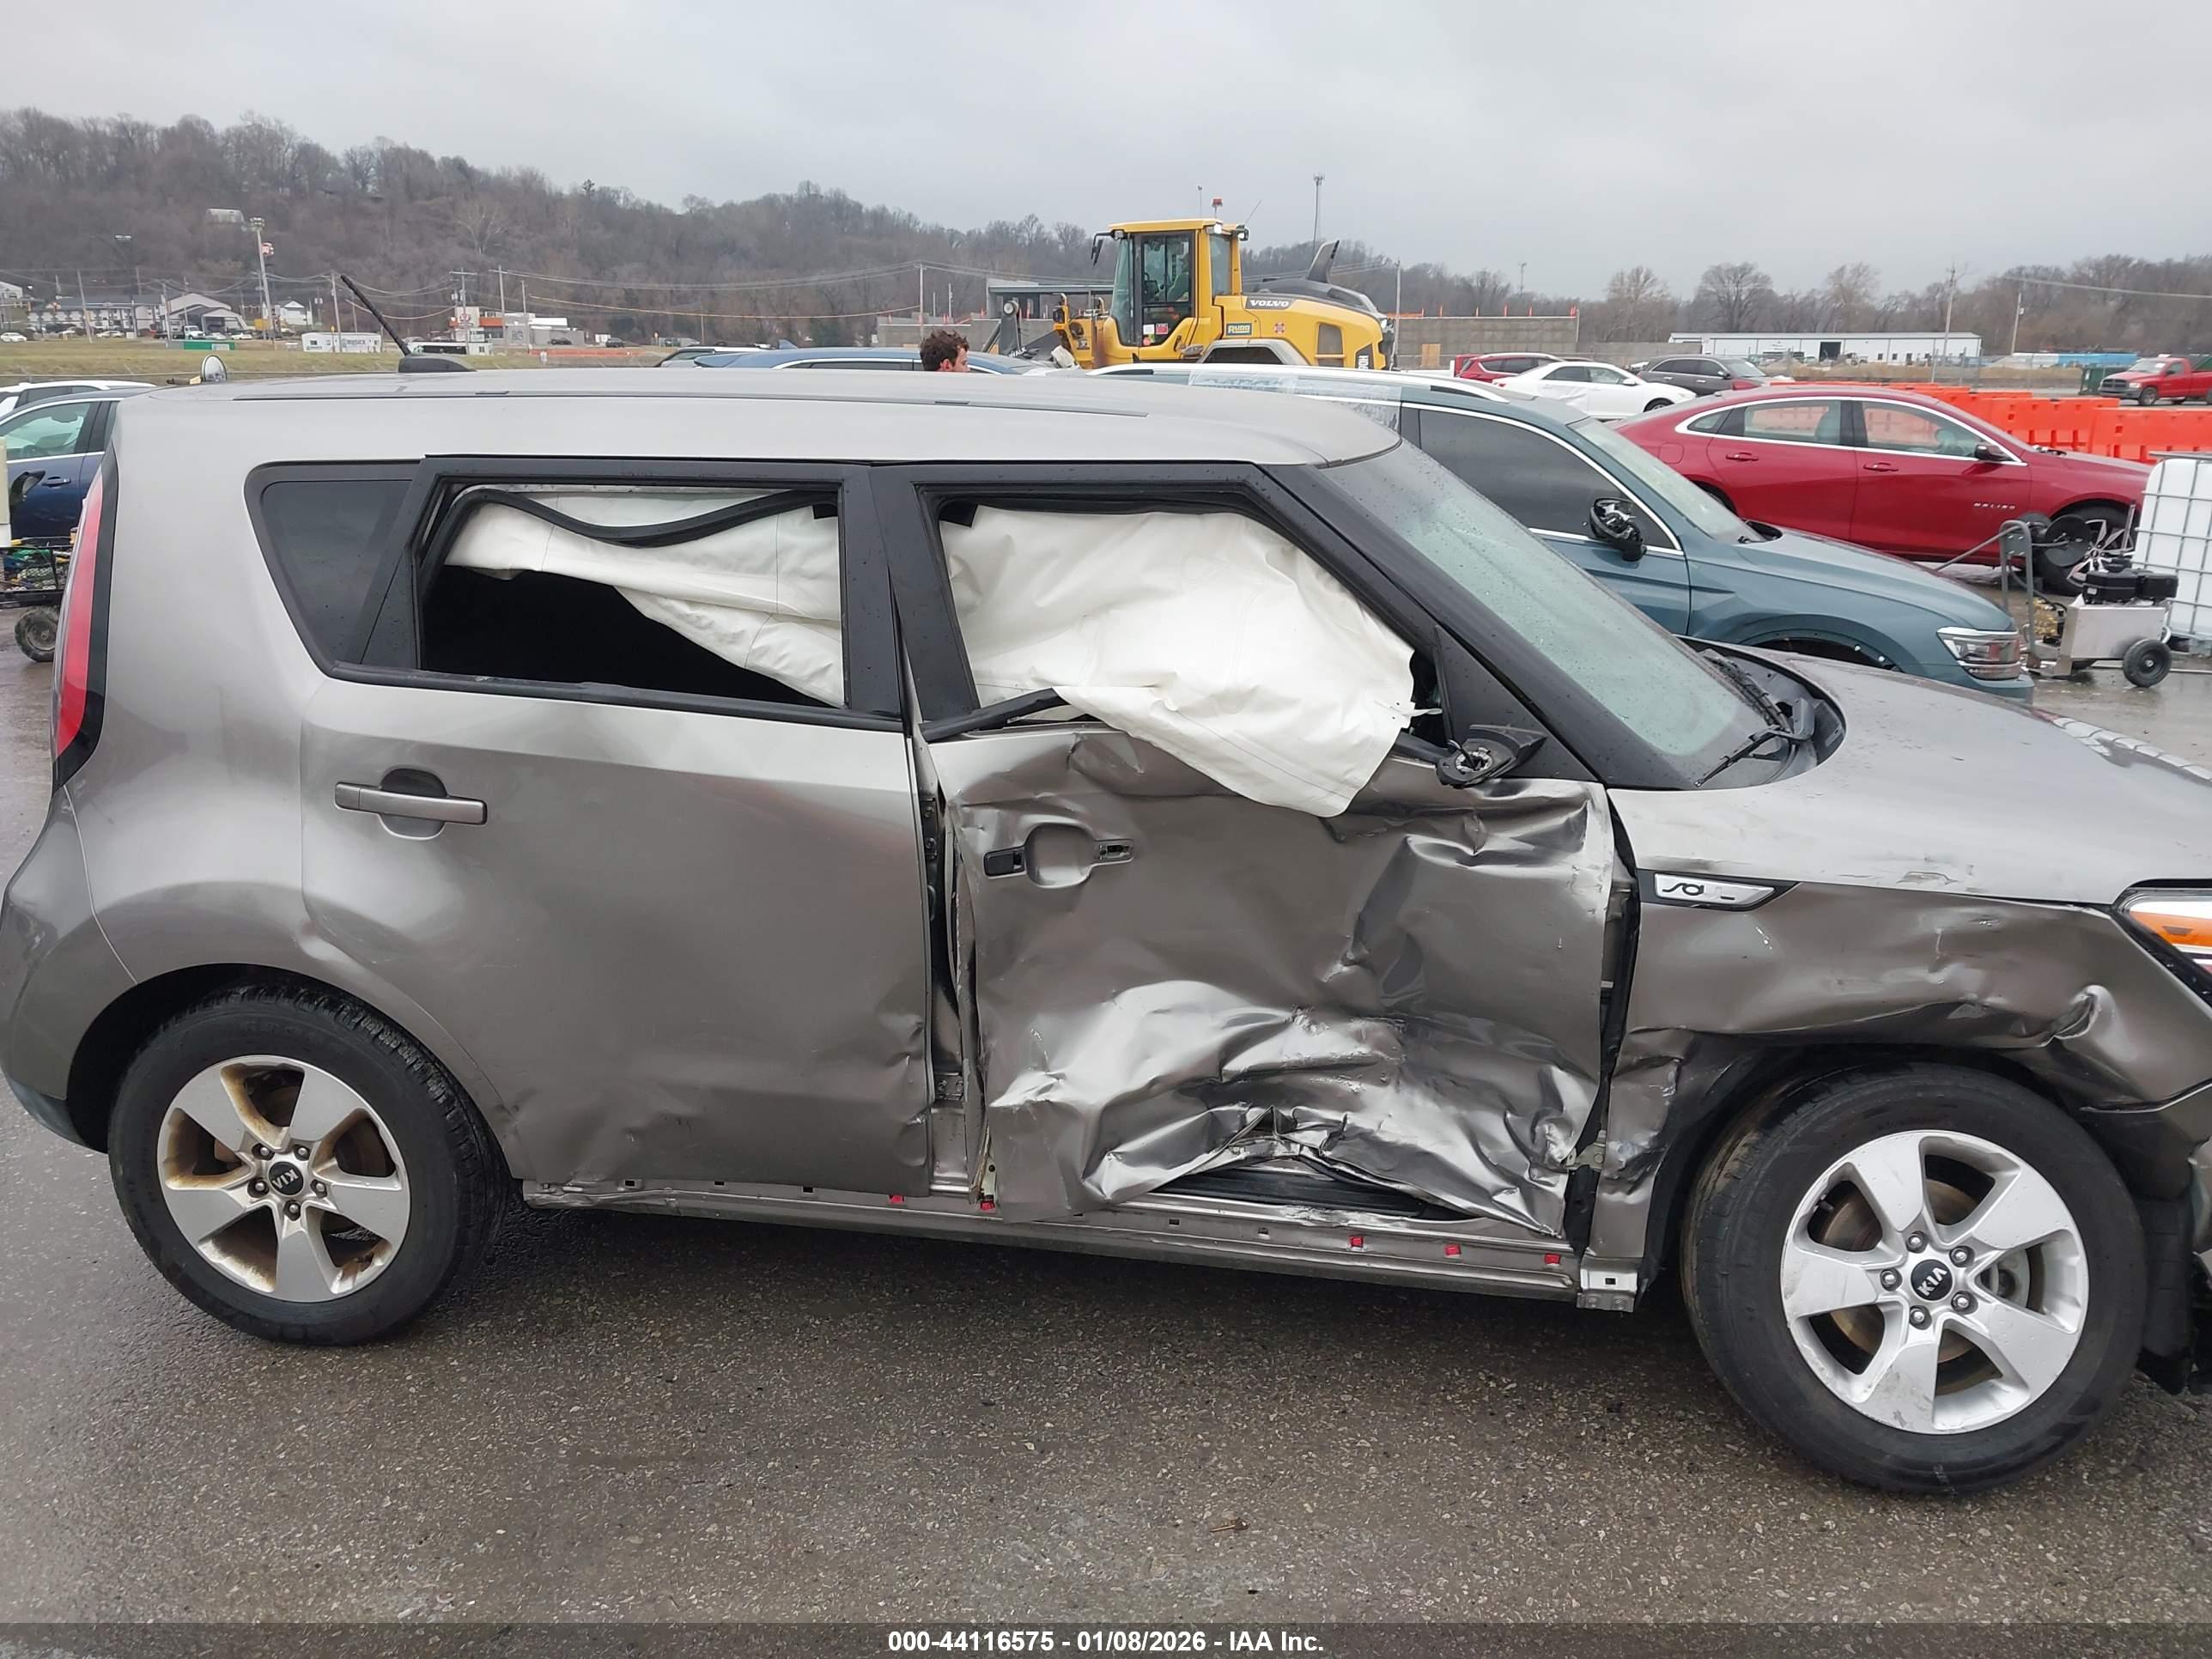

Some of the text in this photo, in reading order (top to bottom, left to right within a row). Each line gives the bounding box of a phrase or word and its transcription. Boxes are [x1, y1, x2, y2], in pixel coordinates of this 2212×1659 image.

[1249, 299, 1290, 307] VOLVO
[271, 1169, 299, 1189] KIA
[1917, 1267, 1948, 1297] KIA
